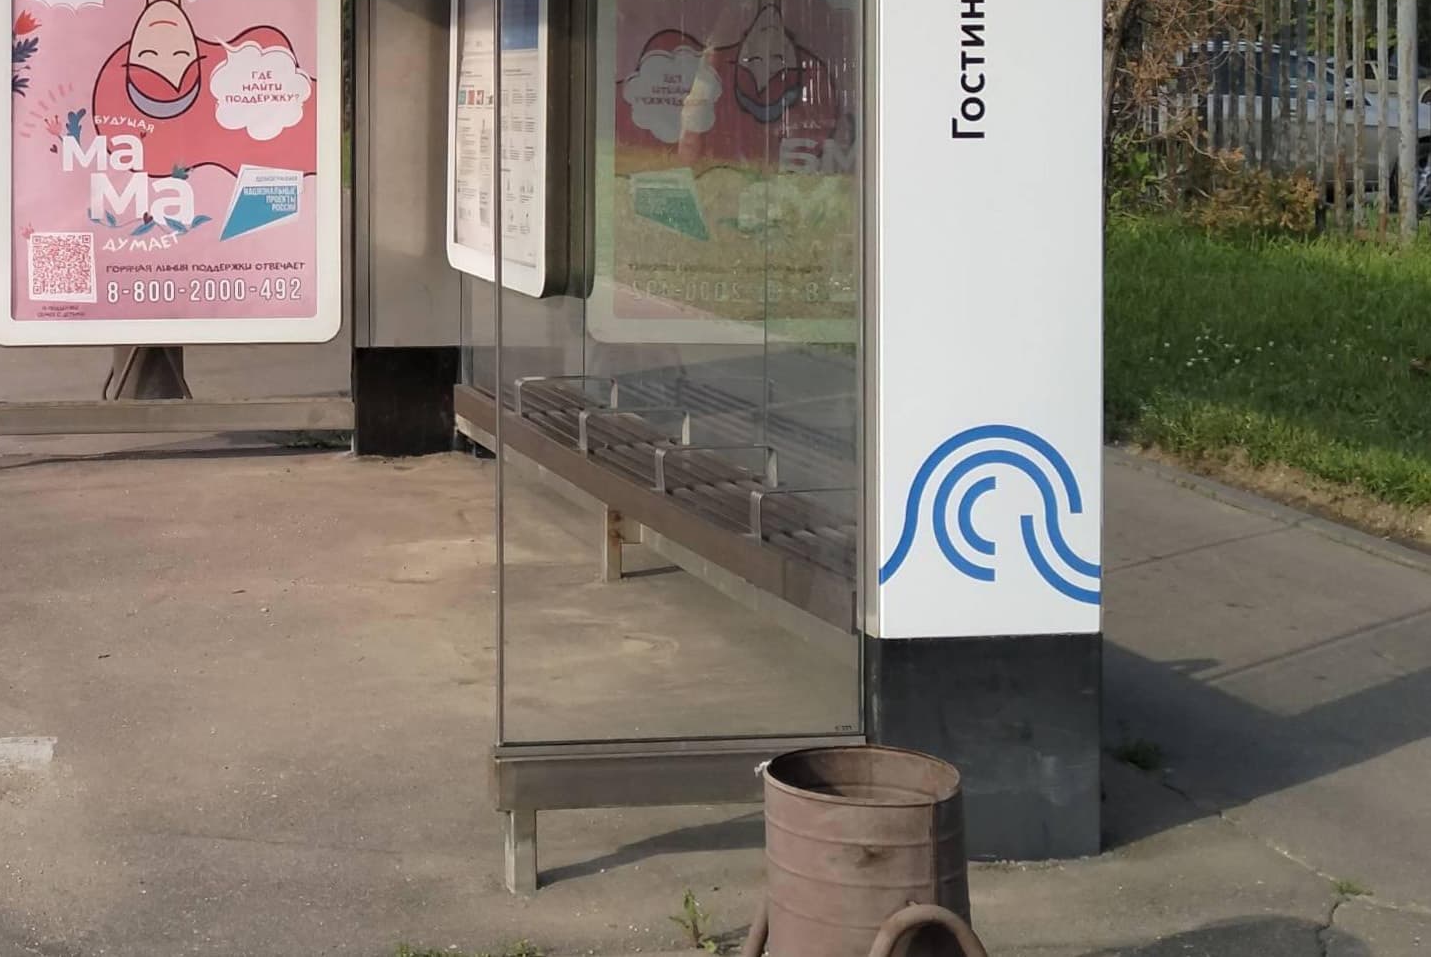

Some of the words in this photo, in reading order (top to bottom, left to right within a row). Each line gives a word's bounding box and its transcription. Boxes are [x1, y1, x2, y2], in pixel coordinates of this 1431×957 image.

[251, 71, 273, 80] ГДЕ
[225, 94, 300, 103] ПОДДЕРЖКУ?
[94, 115, 155, 133] БУДУЩАЯ
[102, 231, 179, 252] ДУМАЕТ
[106, 264, 152, 273] ГОРЯЧАЯ
[156, 264, 188, 272] ЛИНИЯ
[192, 263, 252, 273] ПОДДЕРЖКИ
[255, 262, 306, 271] ОТВЕЧАЕТ
[107, 278, 302, 303] 8-800-2000-492
